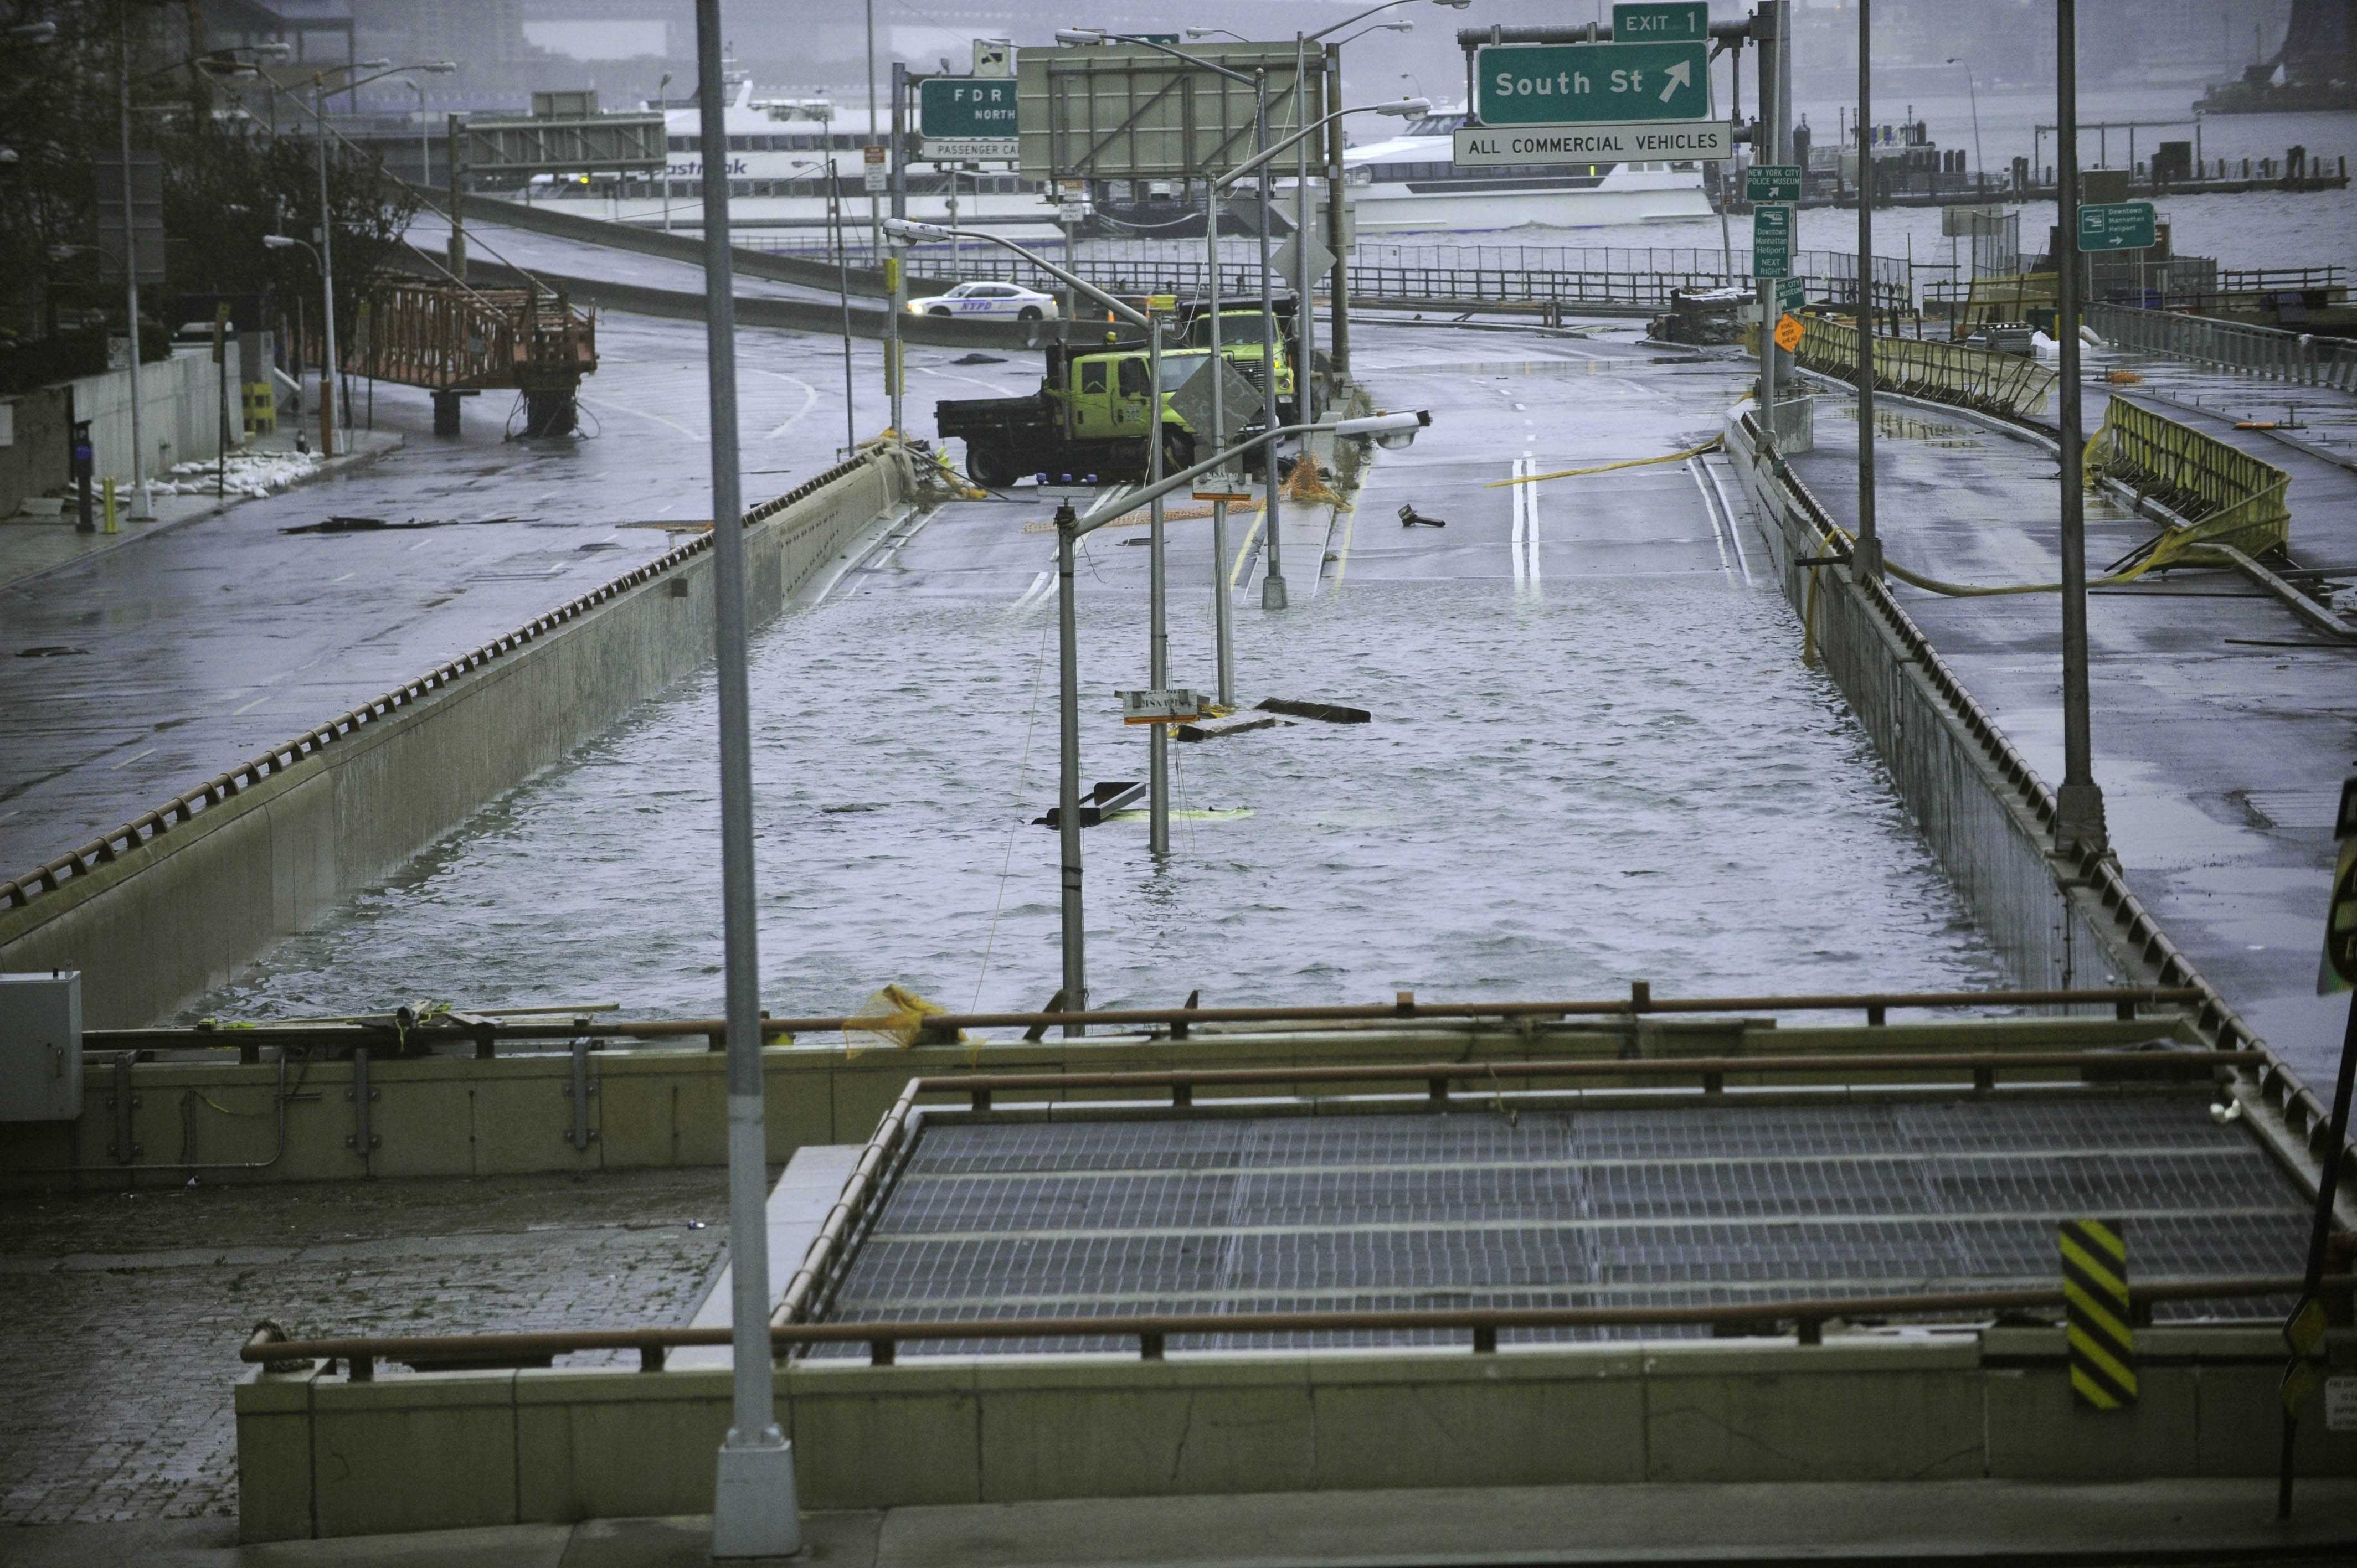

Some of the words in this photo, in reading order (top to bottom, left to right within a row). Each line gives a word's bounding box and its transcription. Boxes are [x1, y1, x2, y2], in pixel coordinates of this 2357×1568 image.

[1626, 15, 1669, 31] EXIT
[1687, 11, 1695, 33] 1
[1495, 71, 1591, 96] South
[1609, 69, 1643, 93] St
[974, 110, 1016, 120] NORTH
[1469, 140, 1501, 154] ALL
[1512, 136, 1624, 154] COMMERCIAL
[1635, 133, 1718, 150] VEHICLES
[938, 145, 999, 155] PASSENGER
[1003, 145, 1019, 155] CA
[1757, 246, 1785, 255] Heliport
[1776, 283, 1786, 291] ORK
[1788, 278, 1799, 288] CITY
[1779, 287, 1802, 298] MUSEUM
[961, 301, 992, 310] NYPD
[1782, 334, 1798, 344] AHEAD
